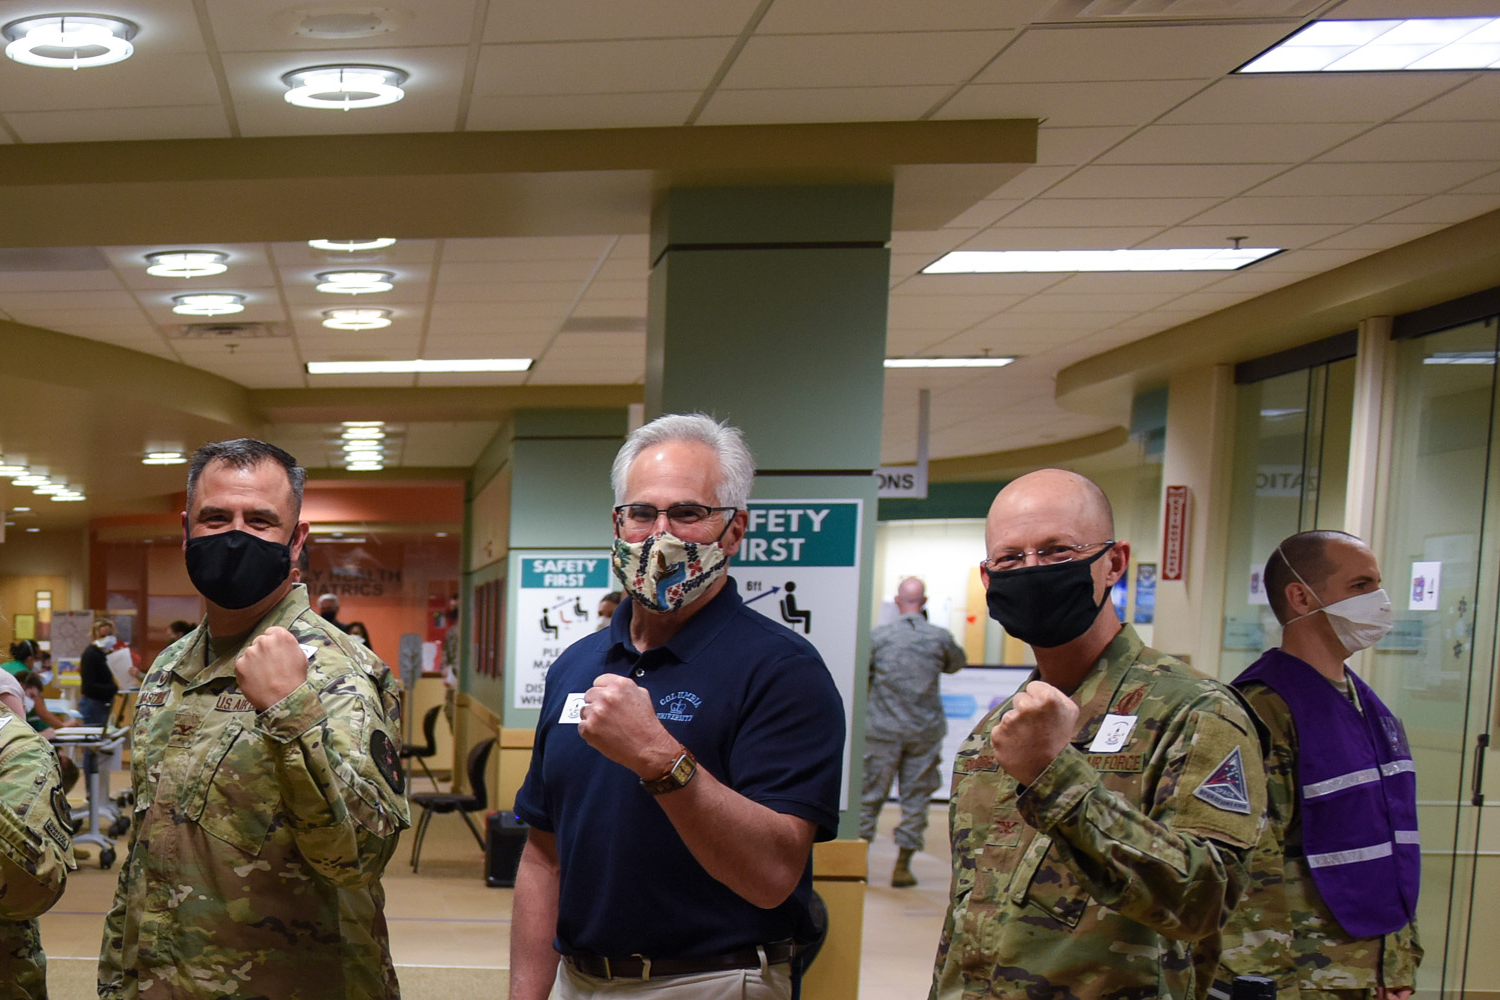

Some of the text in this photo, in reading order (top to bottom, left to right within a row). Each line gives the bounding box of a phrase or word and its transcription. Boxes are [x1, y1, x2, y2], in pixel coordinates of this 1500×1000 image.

[745, 509, 830, 532] FETY
[1168, 500, 1180, 573] EXTINGUISHER
[533, 559, 598, 573] SAFETY
[543, 574, 586, 587] FIRST
[746, 581, 762, 592] 6ft
[234, 699, 250, 710] AIR
[660, 691, 702, 709] COLUMBIA
[1102, 754, 1142, 770] FORCE
[1214, 786, 1235, 798] SPACE
